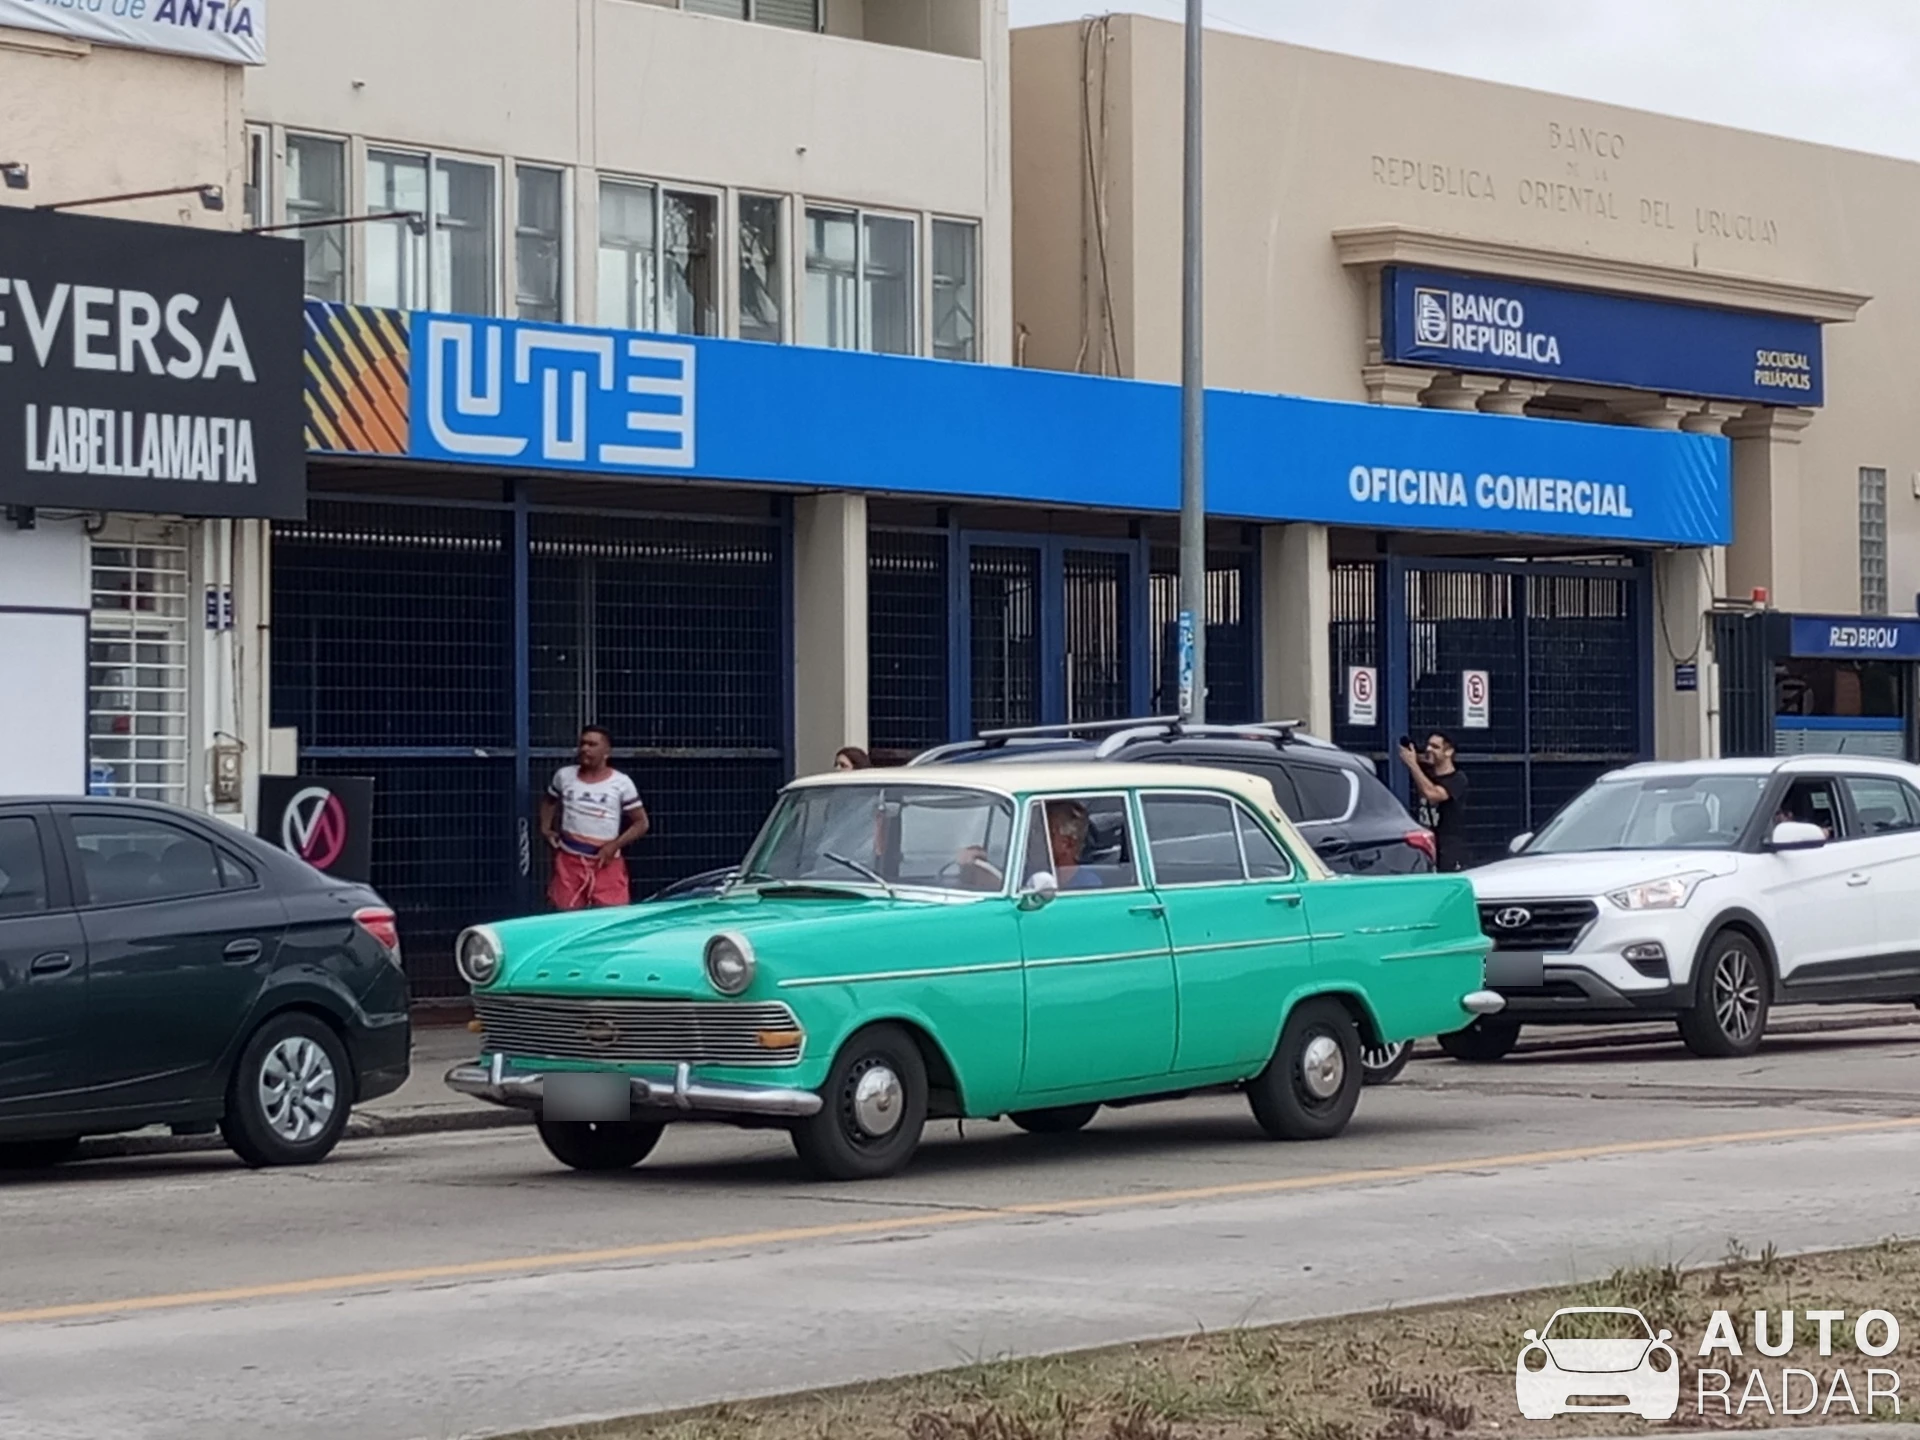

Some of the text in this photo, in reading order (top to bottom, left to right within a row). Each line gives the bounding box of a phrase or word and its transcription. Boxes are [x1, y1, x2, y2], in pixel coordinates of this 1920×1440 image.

[1548, 121, 1625, 160] BANCO
[1371, 154, 1778, 247] REPUBLICA ORIENTAL DEL URUGUAY
[1451, 291, 1524, 328] BANCO
[1451, 321, 1561, 365] REPUBLICA
[1756, 349, 1810, 370] SUCURSAL
[427, 320, 696, 468] UTE
[26, 404, 257, 484] LABELLAMAFIA
[1350, 465, 1633, 518] OFICINA COMERCIAL
